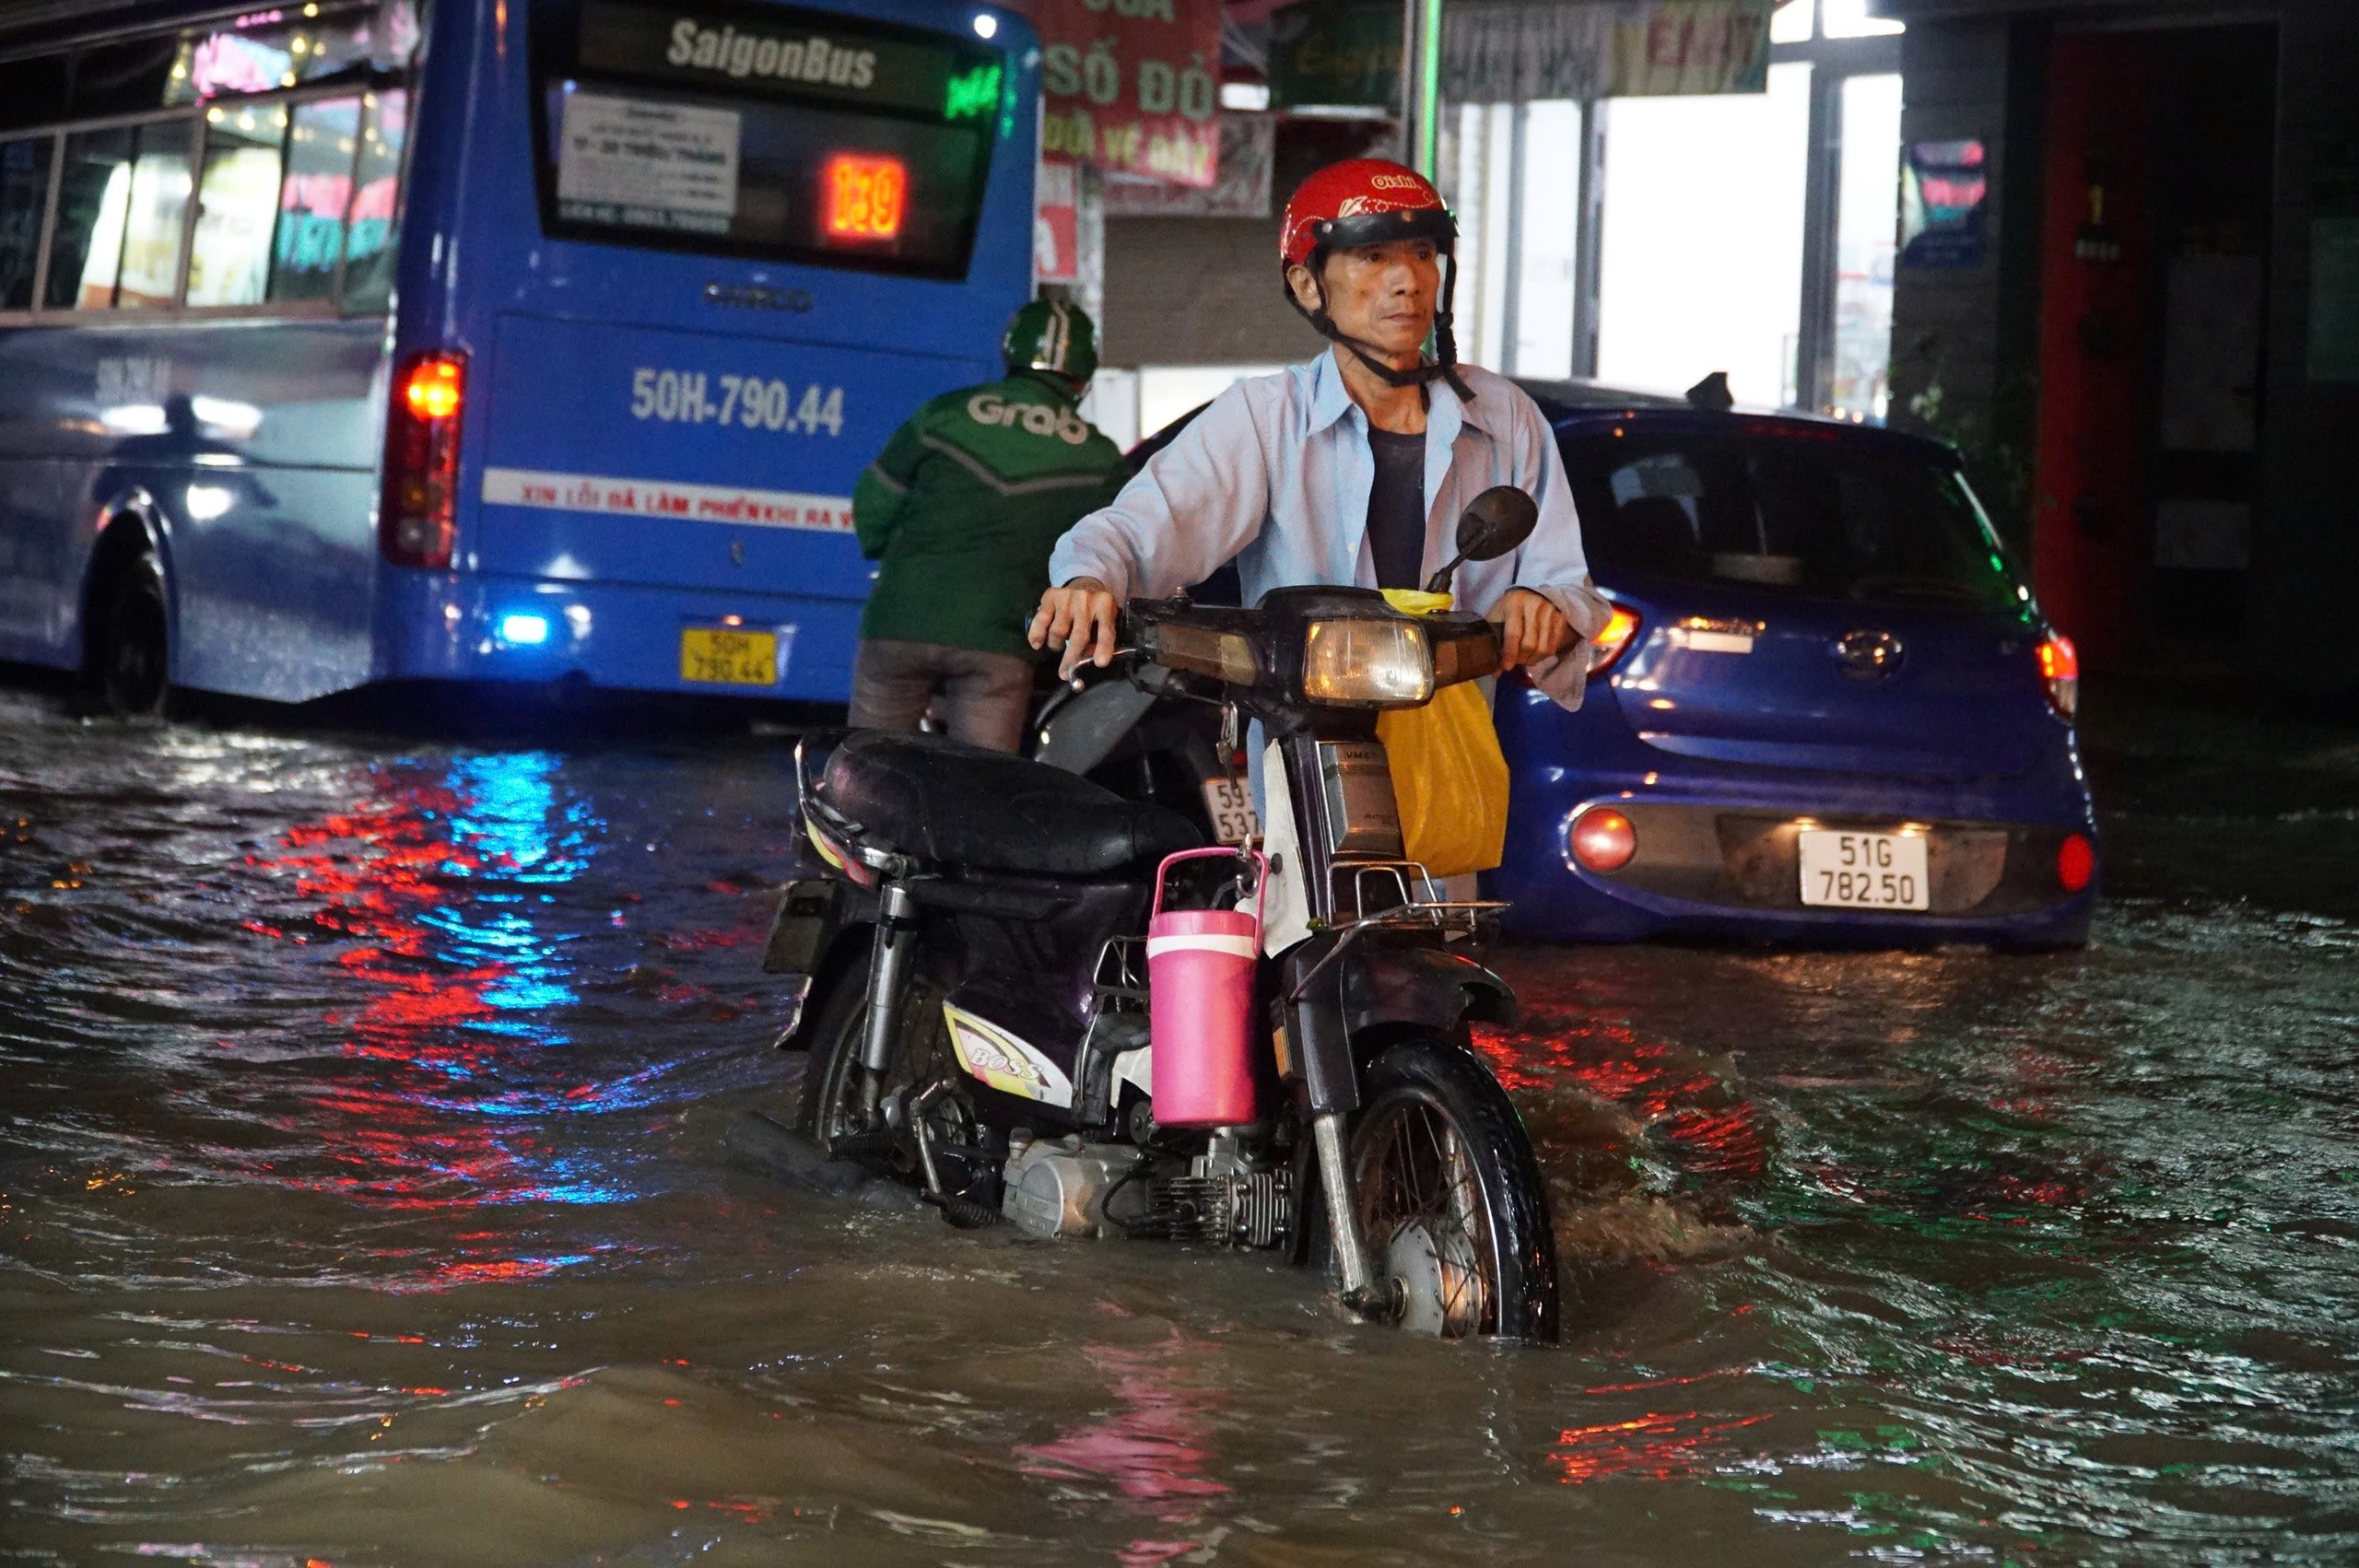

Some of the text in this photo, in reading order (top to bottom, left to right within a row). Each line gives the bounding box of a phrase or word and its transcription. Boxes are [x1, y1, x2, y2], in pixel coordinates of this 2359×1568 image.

[666, 18, 875, 88] SaigonBus
[1371, 175, 1417, 190] Oishi
[630, 367, 844, 437] 50H-790.44
[968, 393, 1089, 445] Grab
[1840, 836, 1893, 868] 51G
[1819, 870, 1915, 905] 782.50
[970, 1047, 1044, 1081] BOSS
